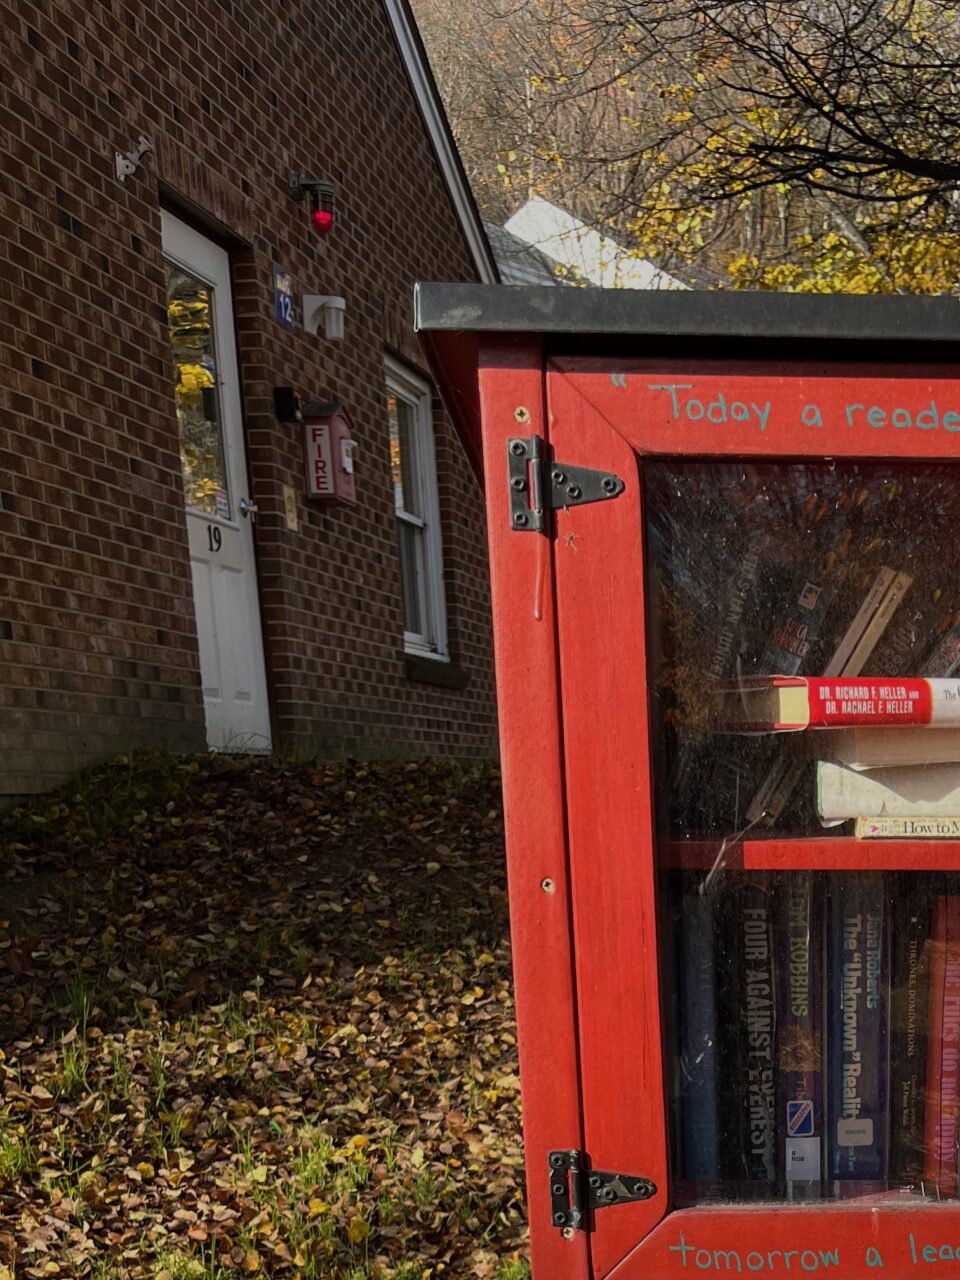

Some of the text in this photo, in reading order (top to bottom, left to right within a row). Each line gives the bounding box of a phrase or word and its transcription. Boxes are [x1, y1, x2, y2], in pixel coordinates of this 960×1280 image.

[279, 293, 293, 323] 12
[801, 406, 822, 426] a
[310, 427, 330, 492] FIRE
[207, 524, 222, 553] 19
[819, 686, 833, 700] DR.
[835, 686, 869, 700] RICHARD
[879, 686, 907, 700] HELLER
[825, 701, 838, 714] DR.
[841, 700, 876, 714] RACHAEL
[886, 700, 913, 714] HELLER
[943, 688, 957, 700] The
[903, 821, 936, 834] How
[936, 822, 951, 834] to
[744, 907, 768, 961] FOUR
[842, 913, 863, 950] The
[788, 936, 810, 1018] ROBBINS
[865, 912, 881, 1009] Jane Roberts
[745, 966, 773, 1063] AGAINST
[905, 939, 918, 1057] THRONES, DOMINATIONS
[940, 1076, 959, 1106] not
[933, 1113, 957, 1164] apply
[669, 1231, 841, 1272] tomorrow
[865, 1248, 884, 1268] a
